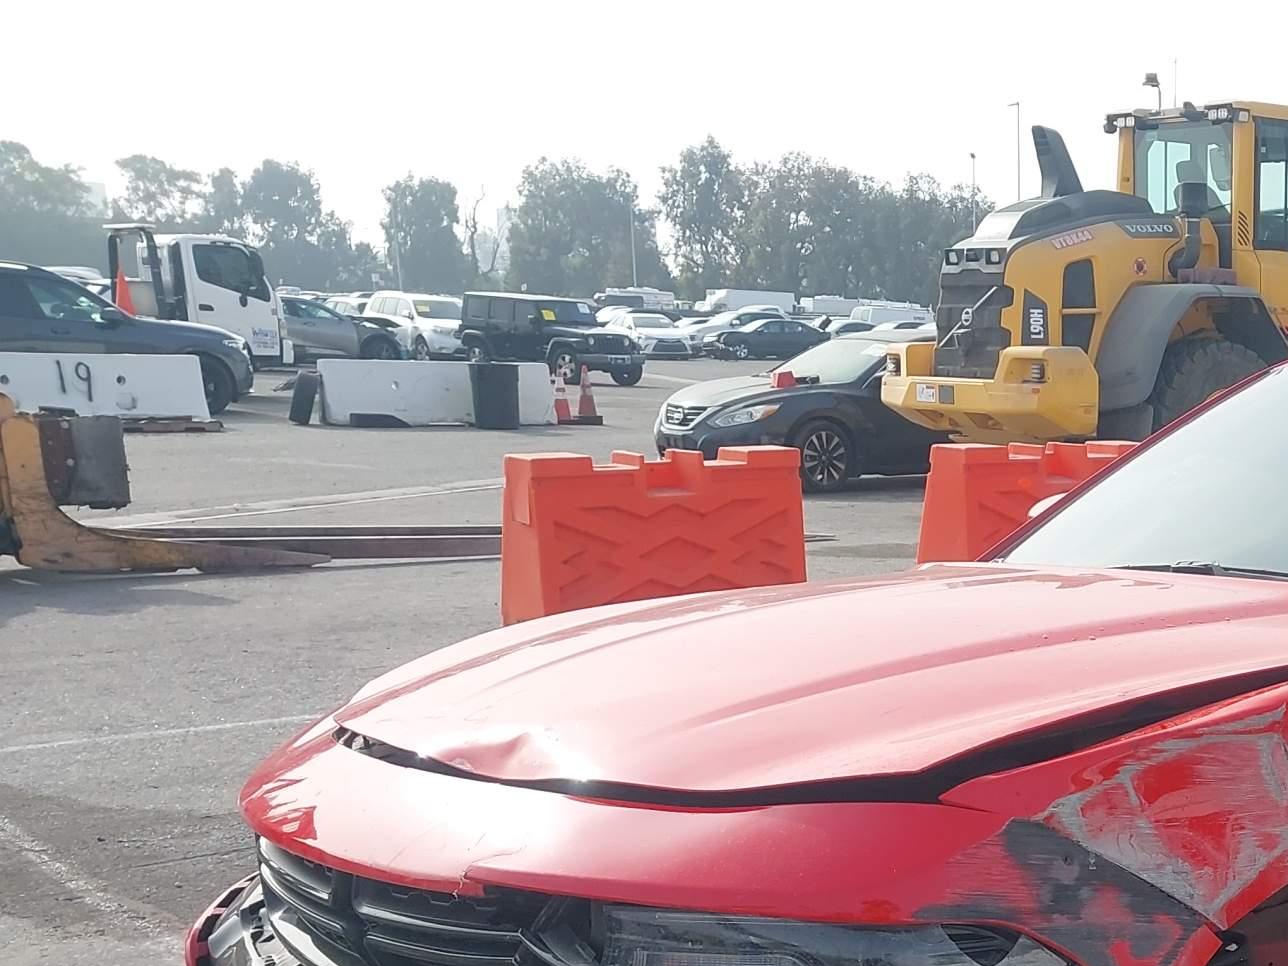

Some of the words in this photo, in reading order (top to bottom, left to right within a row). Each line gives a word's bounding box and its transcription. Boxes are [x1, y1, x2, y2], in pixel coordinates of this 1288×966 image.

[1125, 224, 1174, 233] VOLVO
[1029, 309, 1044, 339] L90H
[56, 360, 93, 402] 19
